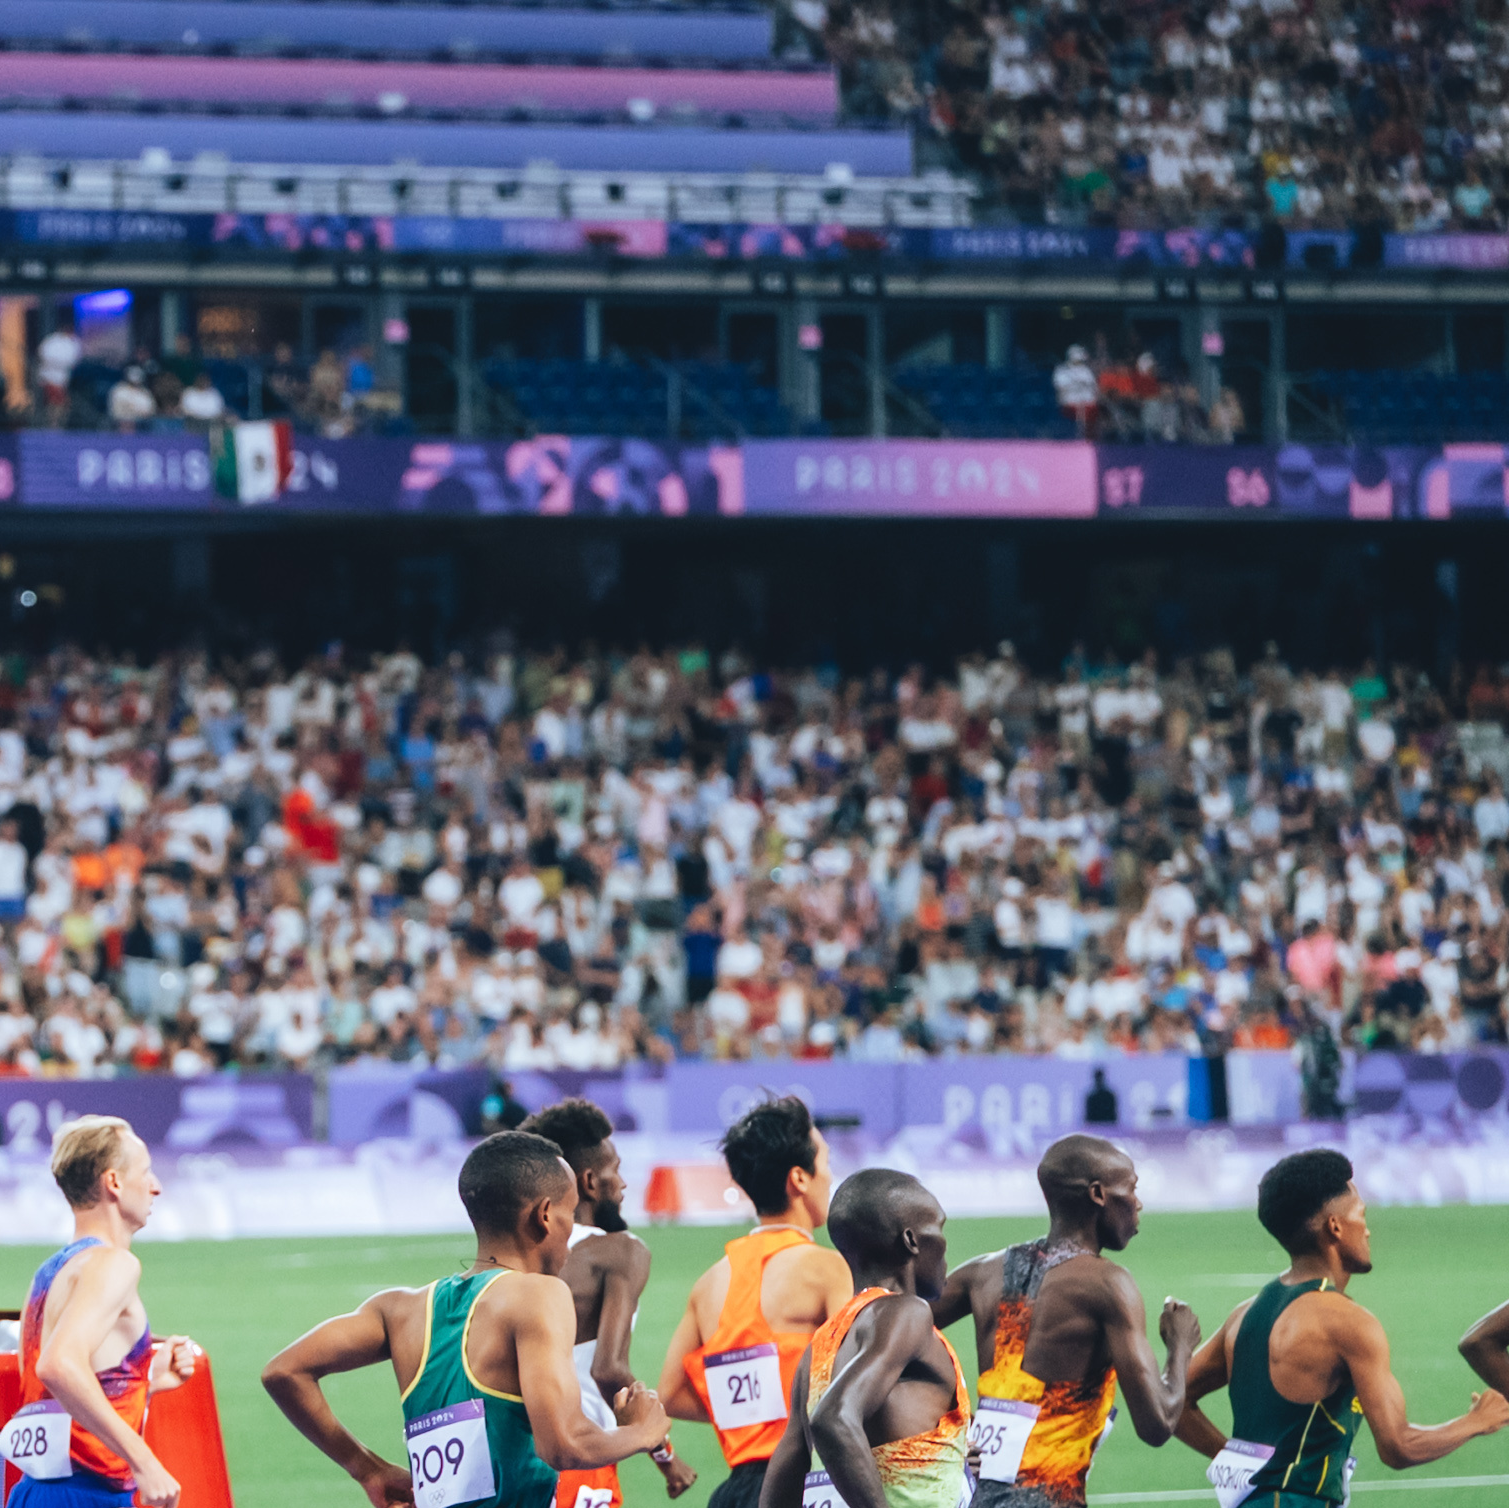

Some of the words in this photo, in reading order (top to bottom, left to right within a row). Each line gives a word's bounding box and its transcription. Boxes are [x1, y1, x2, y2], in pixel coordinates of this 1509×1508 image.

[77, 448, 211, 492] PARIS
[290, 450, 340, 492] 24
[794, 454, 918, 497] PARIS
[929, 455, 1042, 498] 2024
[728, 1371, 760, 1405] 216
[409, 1418, 431, 1433] PARIS
[431, 1411, 454, 1427] 2024
[11, 1427, 47, 1458] 228
[411, 1437, 465, 1490] 209
